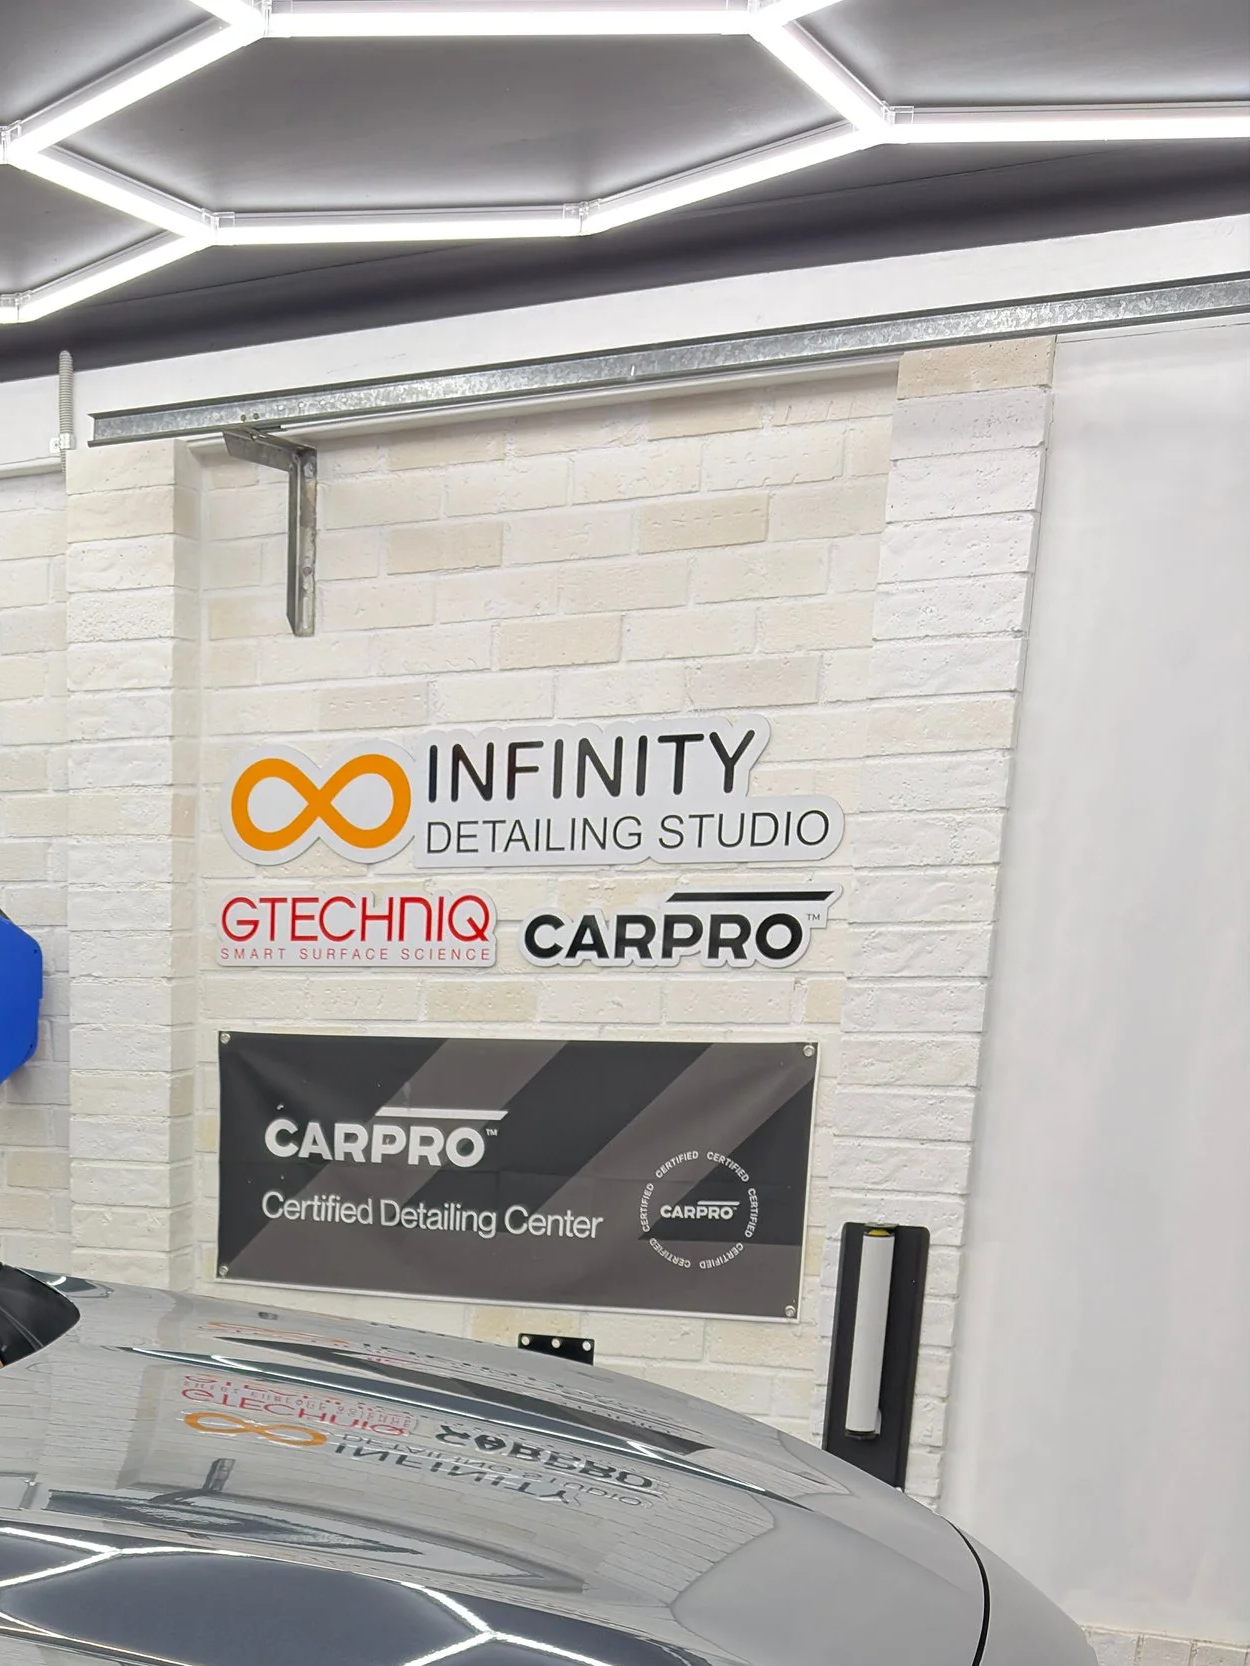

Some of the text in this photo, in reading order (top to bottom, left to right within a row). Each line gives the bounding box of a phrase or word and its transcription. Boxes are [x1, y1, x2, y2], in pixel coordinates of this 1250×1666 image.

[428, 730, 756, 804] INFINITY
[426, 809, 830, 854] DETAILING STUDIO
[220, 894, 491, 943] GTECHNIQ
[523, 912, 804, 960] CARPRO
[220, 947, 490, 960] SMART SURFACE SCIENCE
[263, 1117, 486, 1168] CARPRO
[655, 1150, 699, 1178] CERTIFIED
[706, 1151, 749, 1182] CERTIFIED
[261, 1190, 604, 1239] Certified Detailing Center
[639, 1183, 655, 1233] CERTIFIED
[659, 1204, 734, 1220] CARPRO
[744, 1187, 760, 1238] CERTIFIED
[649, 1237, 692, 1269] CERTIFIED
[699, 1242, 744, 1269] CERTIFIED
